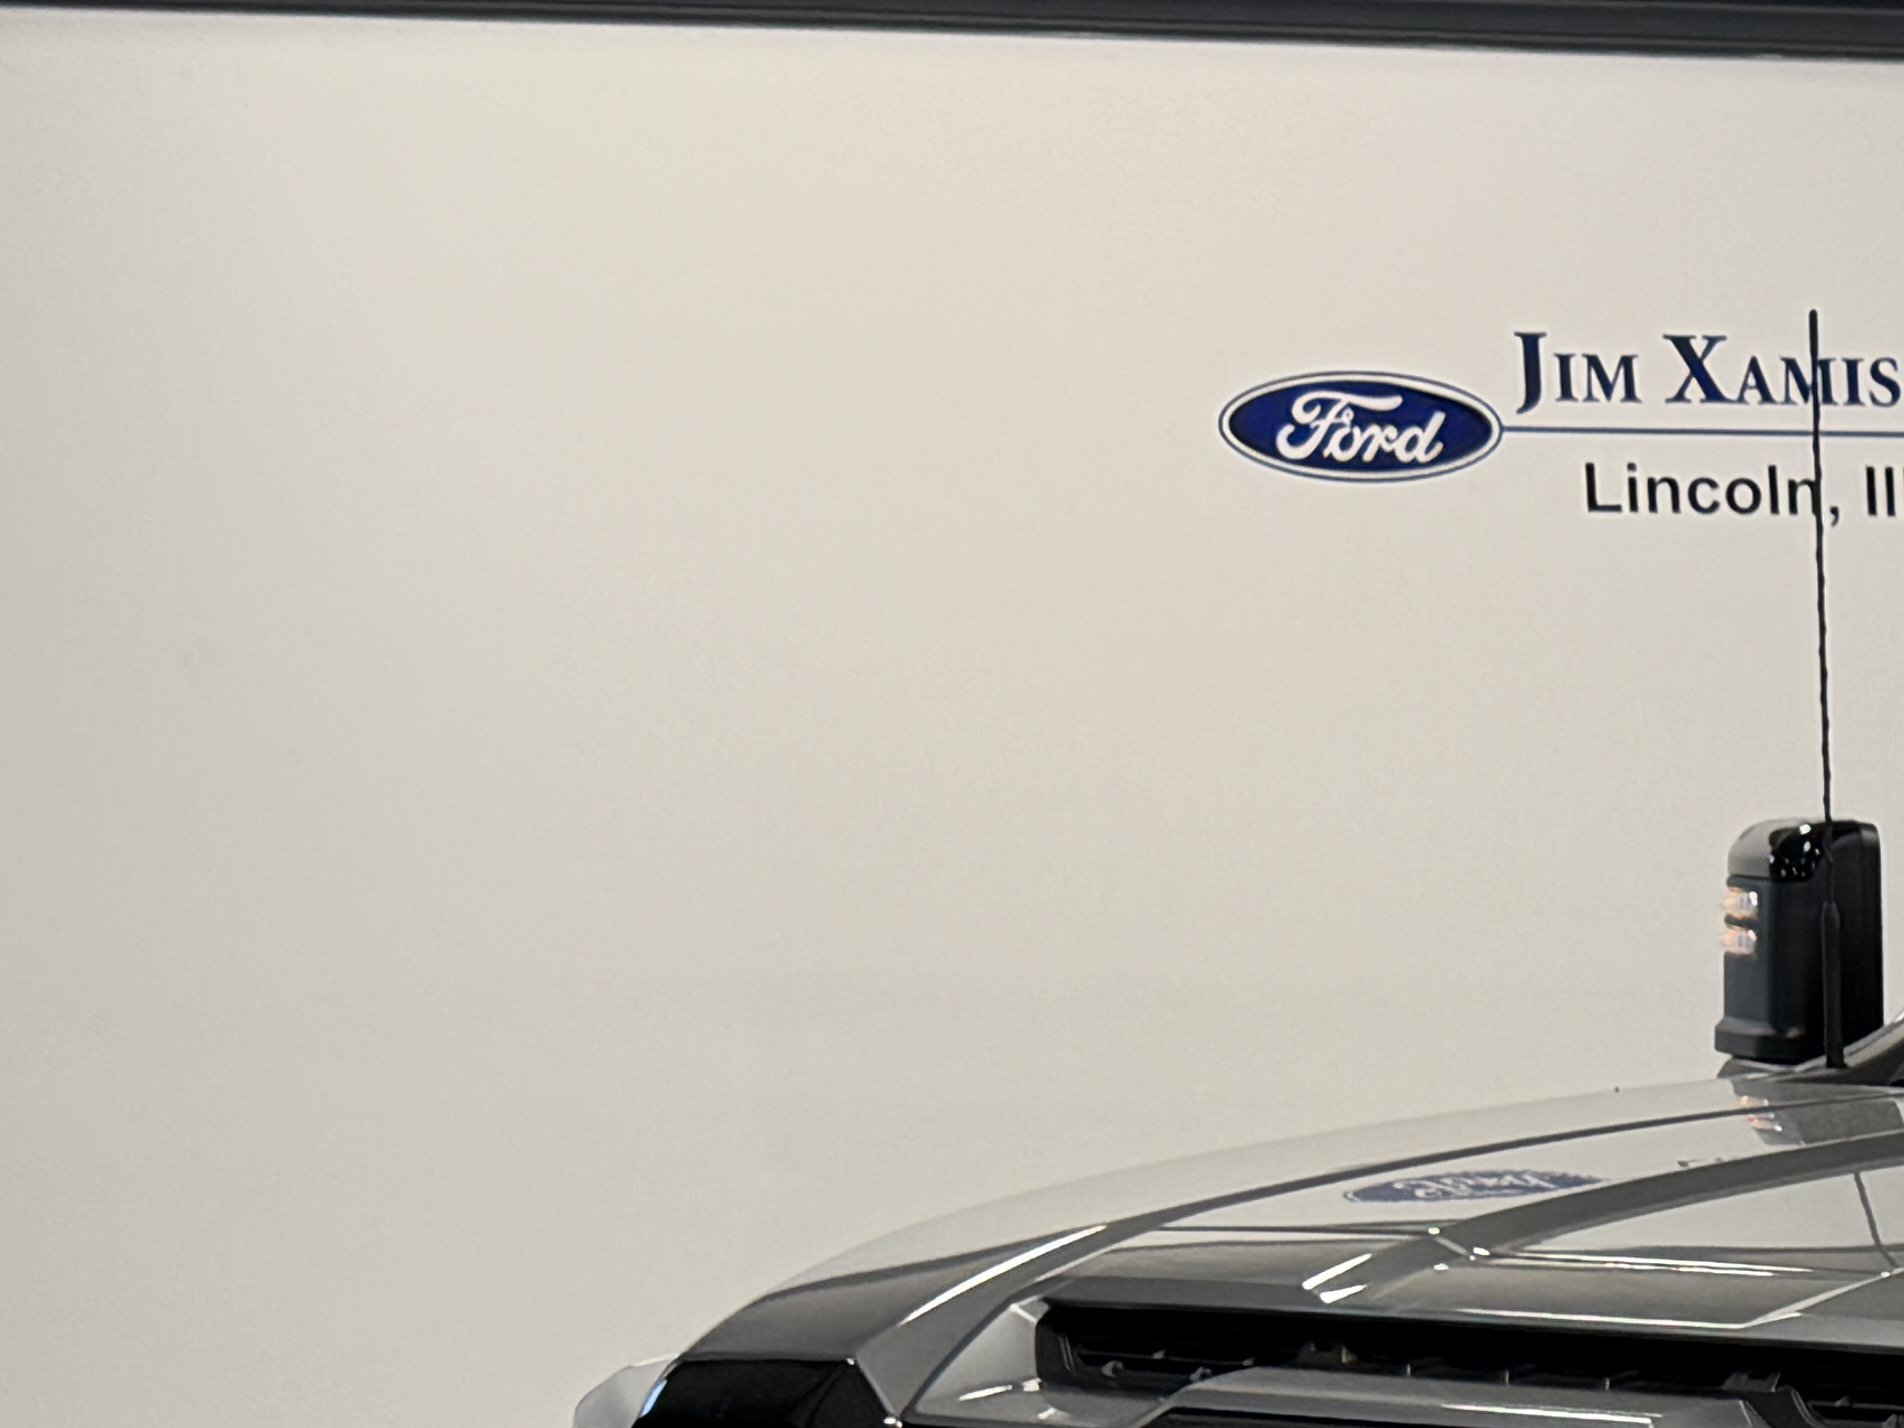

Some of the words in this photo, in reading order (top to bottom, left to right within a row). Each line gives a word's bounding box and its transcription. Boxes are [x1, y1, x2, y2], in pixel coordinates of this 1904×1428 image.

[1514, 331, 1640, 415] JIM
[1663, 333, 1903, 408] XAMIS
[1275, 391, 1443, 465] Ford
[1584, 462, 1841, 527] Lincoln,
